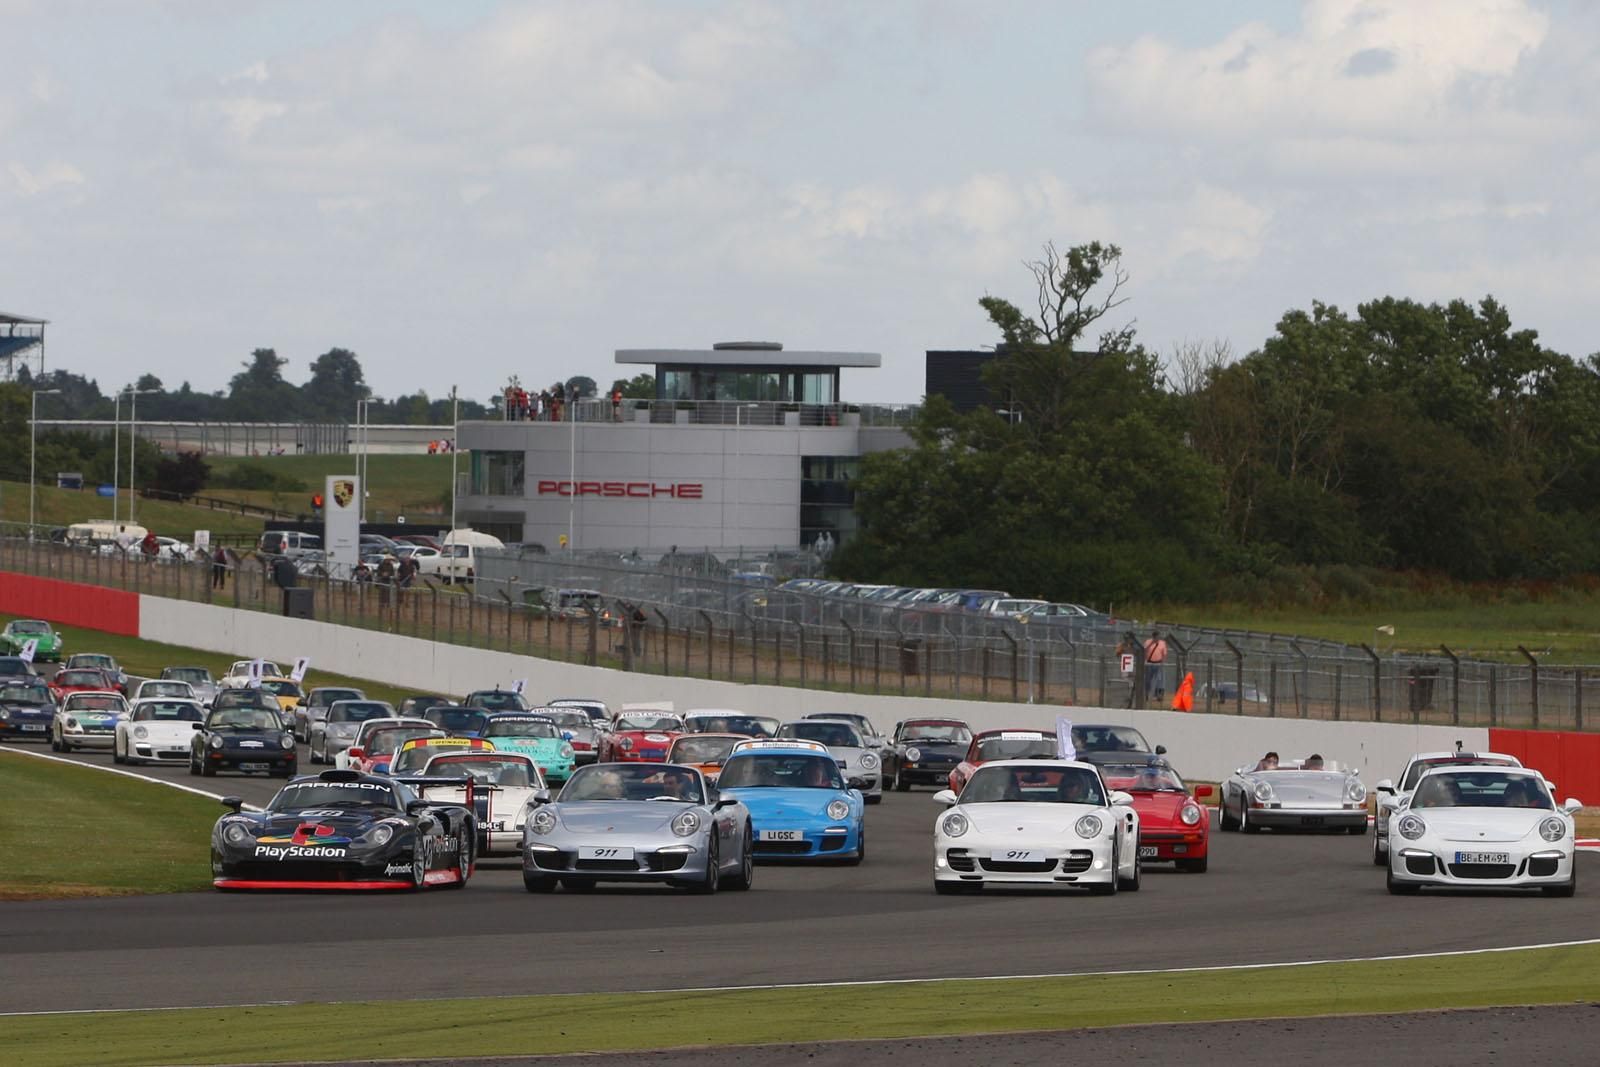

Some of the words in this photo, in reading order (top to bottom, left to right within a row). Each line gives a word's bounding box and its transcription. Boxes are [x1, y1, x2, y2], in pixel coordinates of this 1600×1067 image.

[538, 480, 703, 499] PORSCHE
[1122, 656, 1132, 671] F
[284, 782, 391, 793] PARAGON
[254, 846, 346, 861] PlayStation
[594, 848, 618, 857] 911
[1007, 850, 1030, 860] 911
[384, 862, 413, 877] Aprimatic
